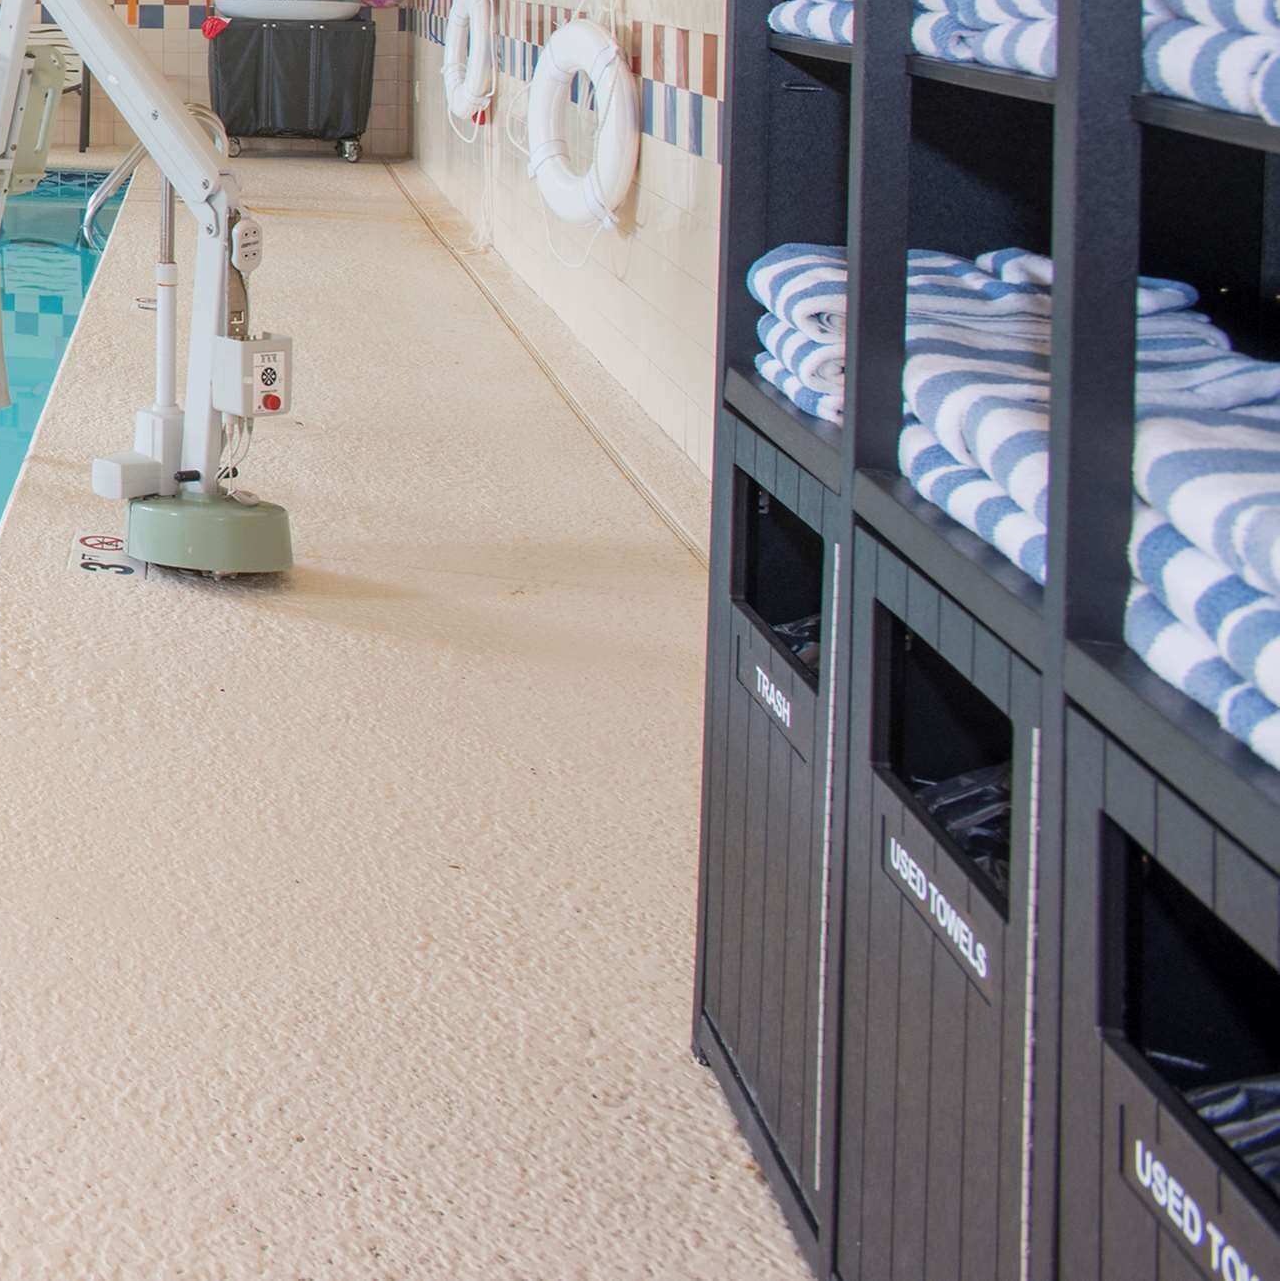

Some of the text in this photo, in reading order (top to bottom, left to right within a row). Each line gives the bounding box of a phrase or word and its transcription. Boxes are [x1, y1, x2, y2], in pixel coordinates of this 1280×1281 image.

[80, 562, 135, 575] 3
[755, 665, 791, 728] TRASH
[890, 837, 988, 979] USED TOWELS
[1135, 1139, 1202, 1246] USED
